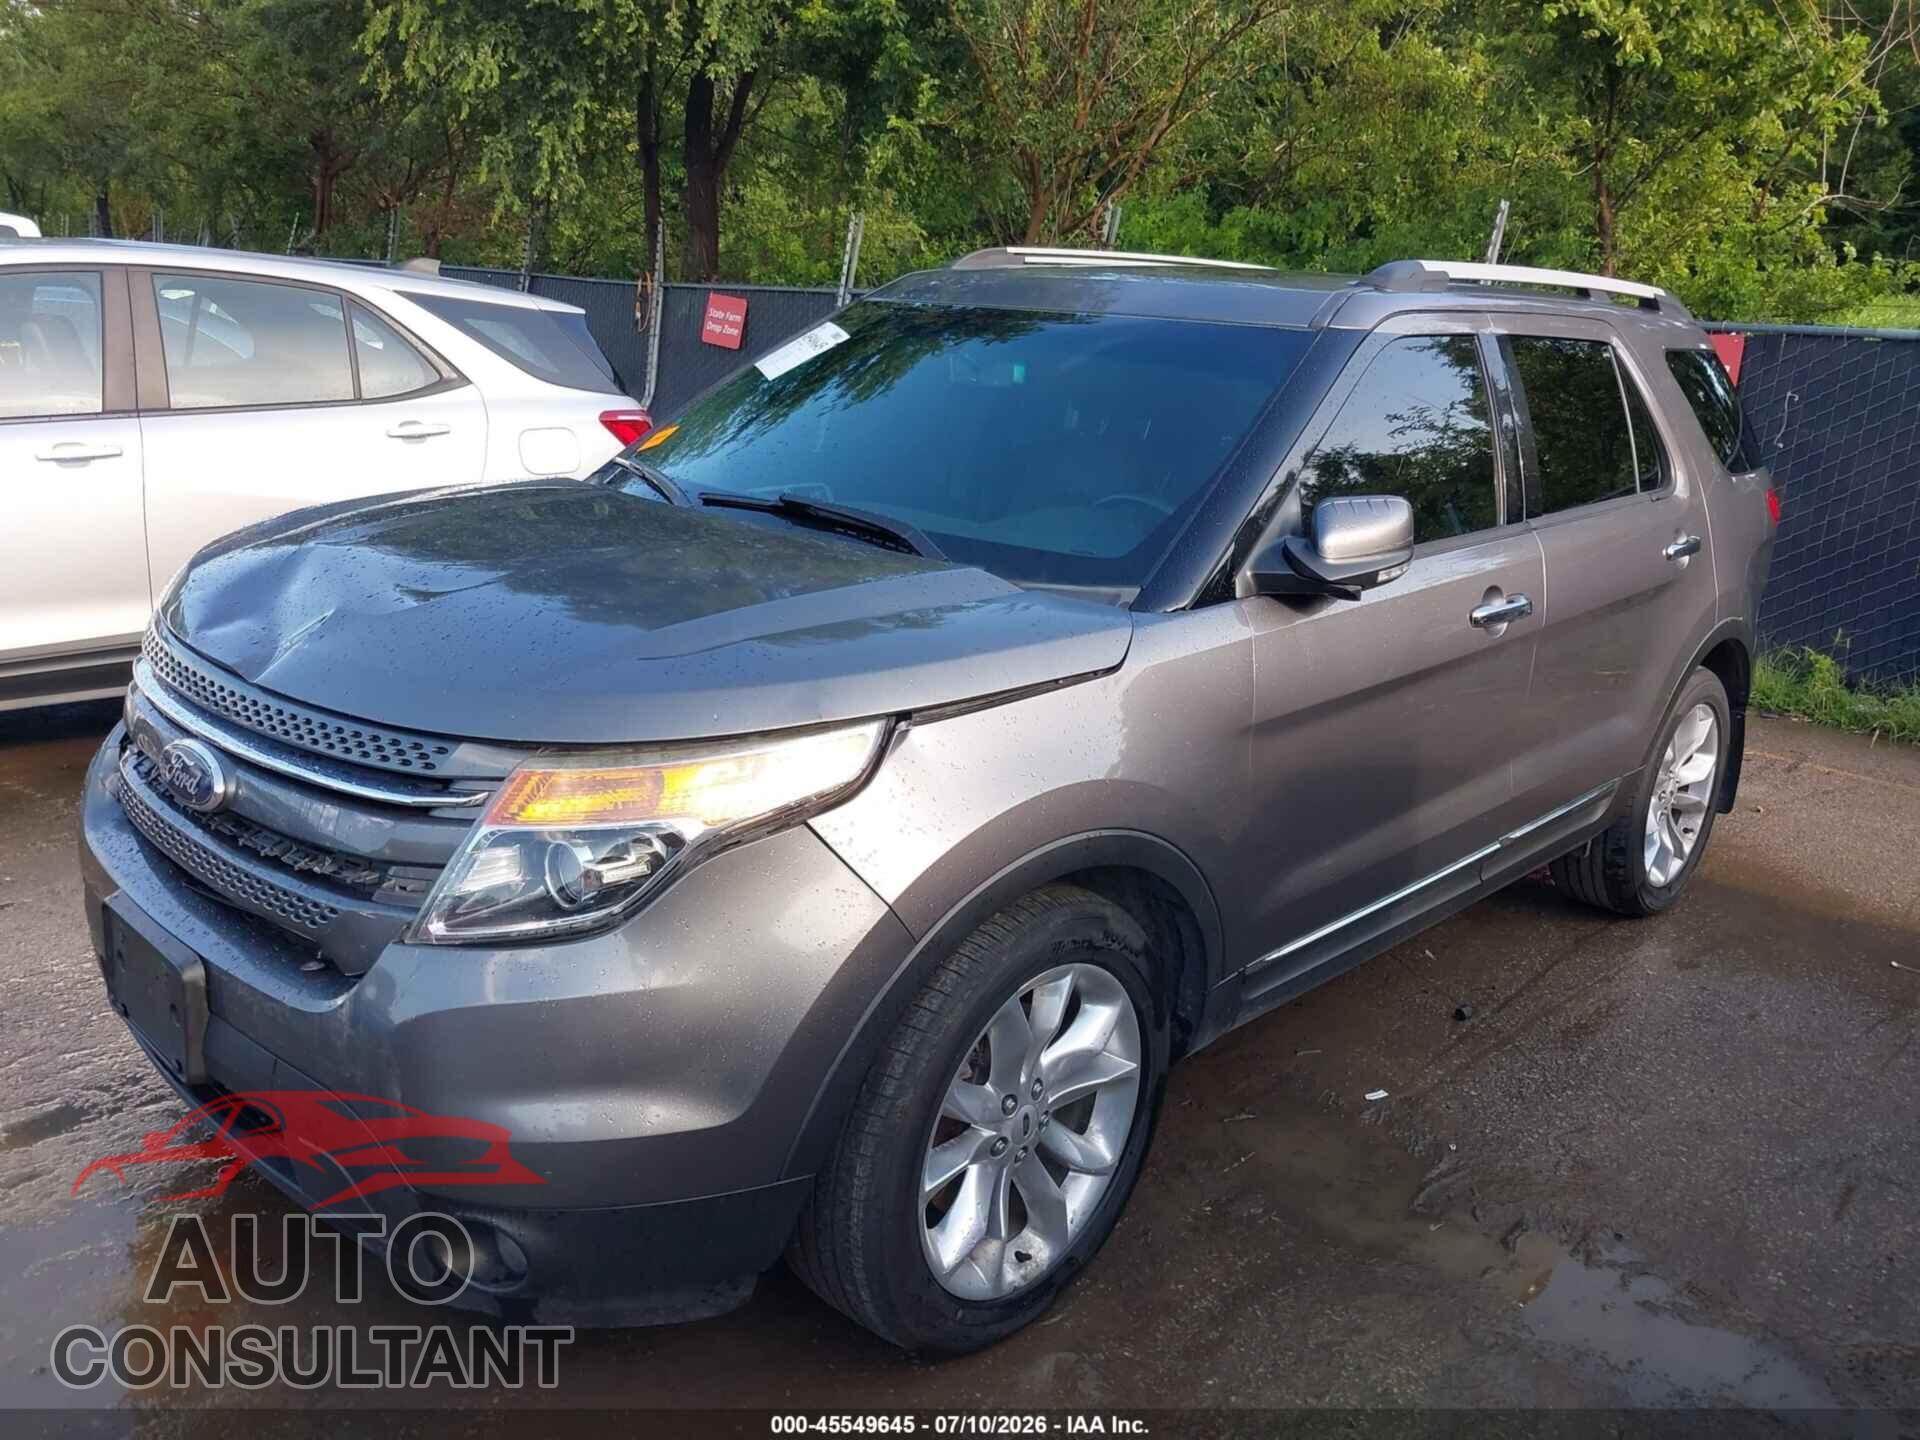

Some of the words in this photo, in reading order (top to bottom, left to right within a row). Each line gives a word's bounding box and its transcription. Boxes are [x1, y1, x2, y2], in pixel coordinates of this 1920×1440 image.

[708, 308, 725, 320] State
[725, 311, 742, 322] Farm
[706, 320, 722, 334] Drop
[722, 324, 739, 336] Zone
[165, 750, 200, 796] Ford
